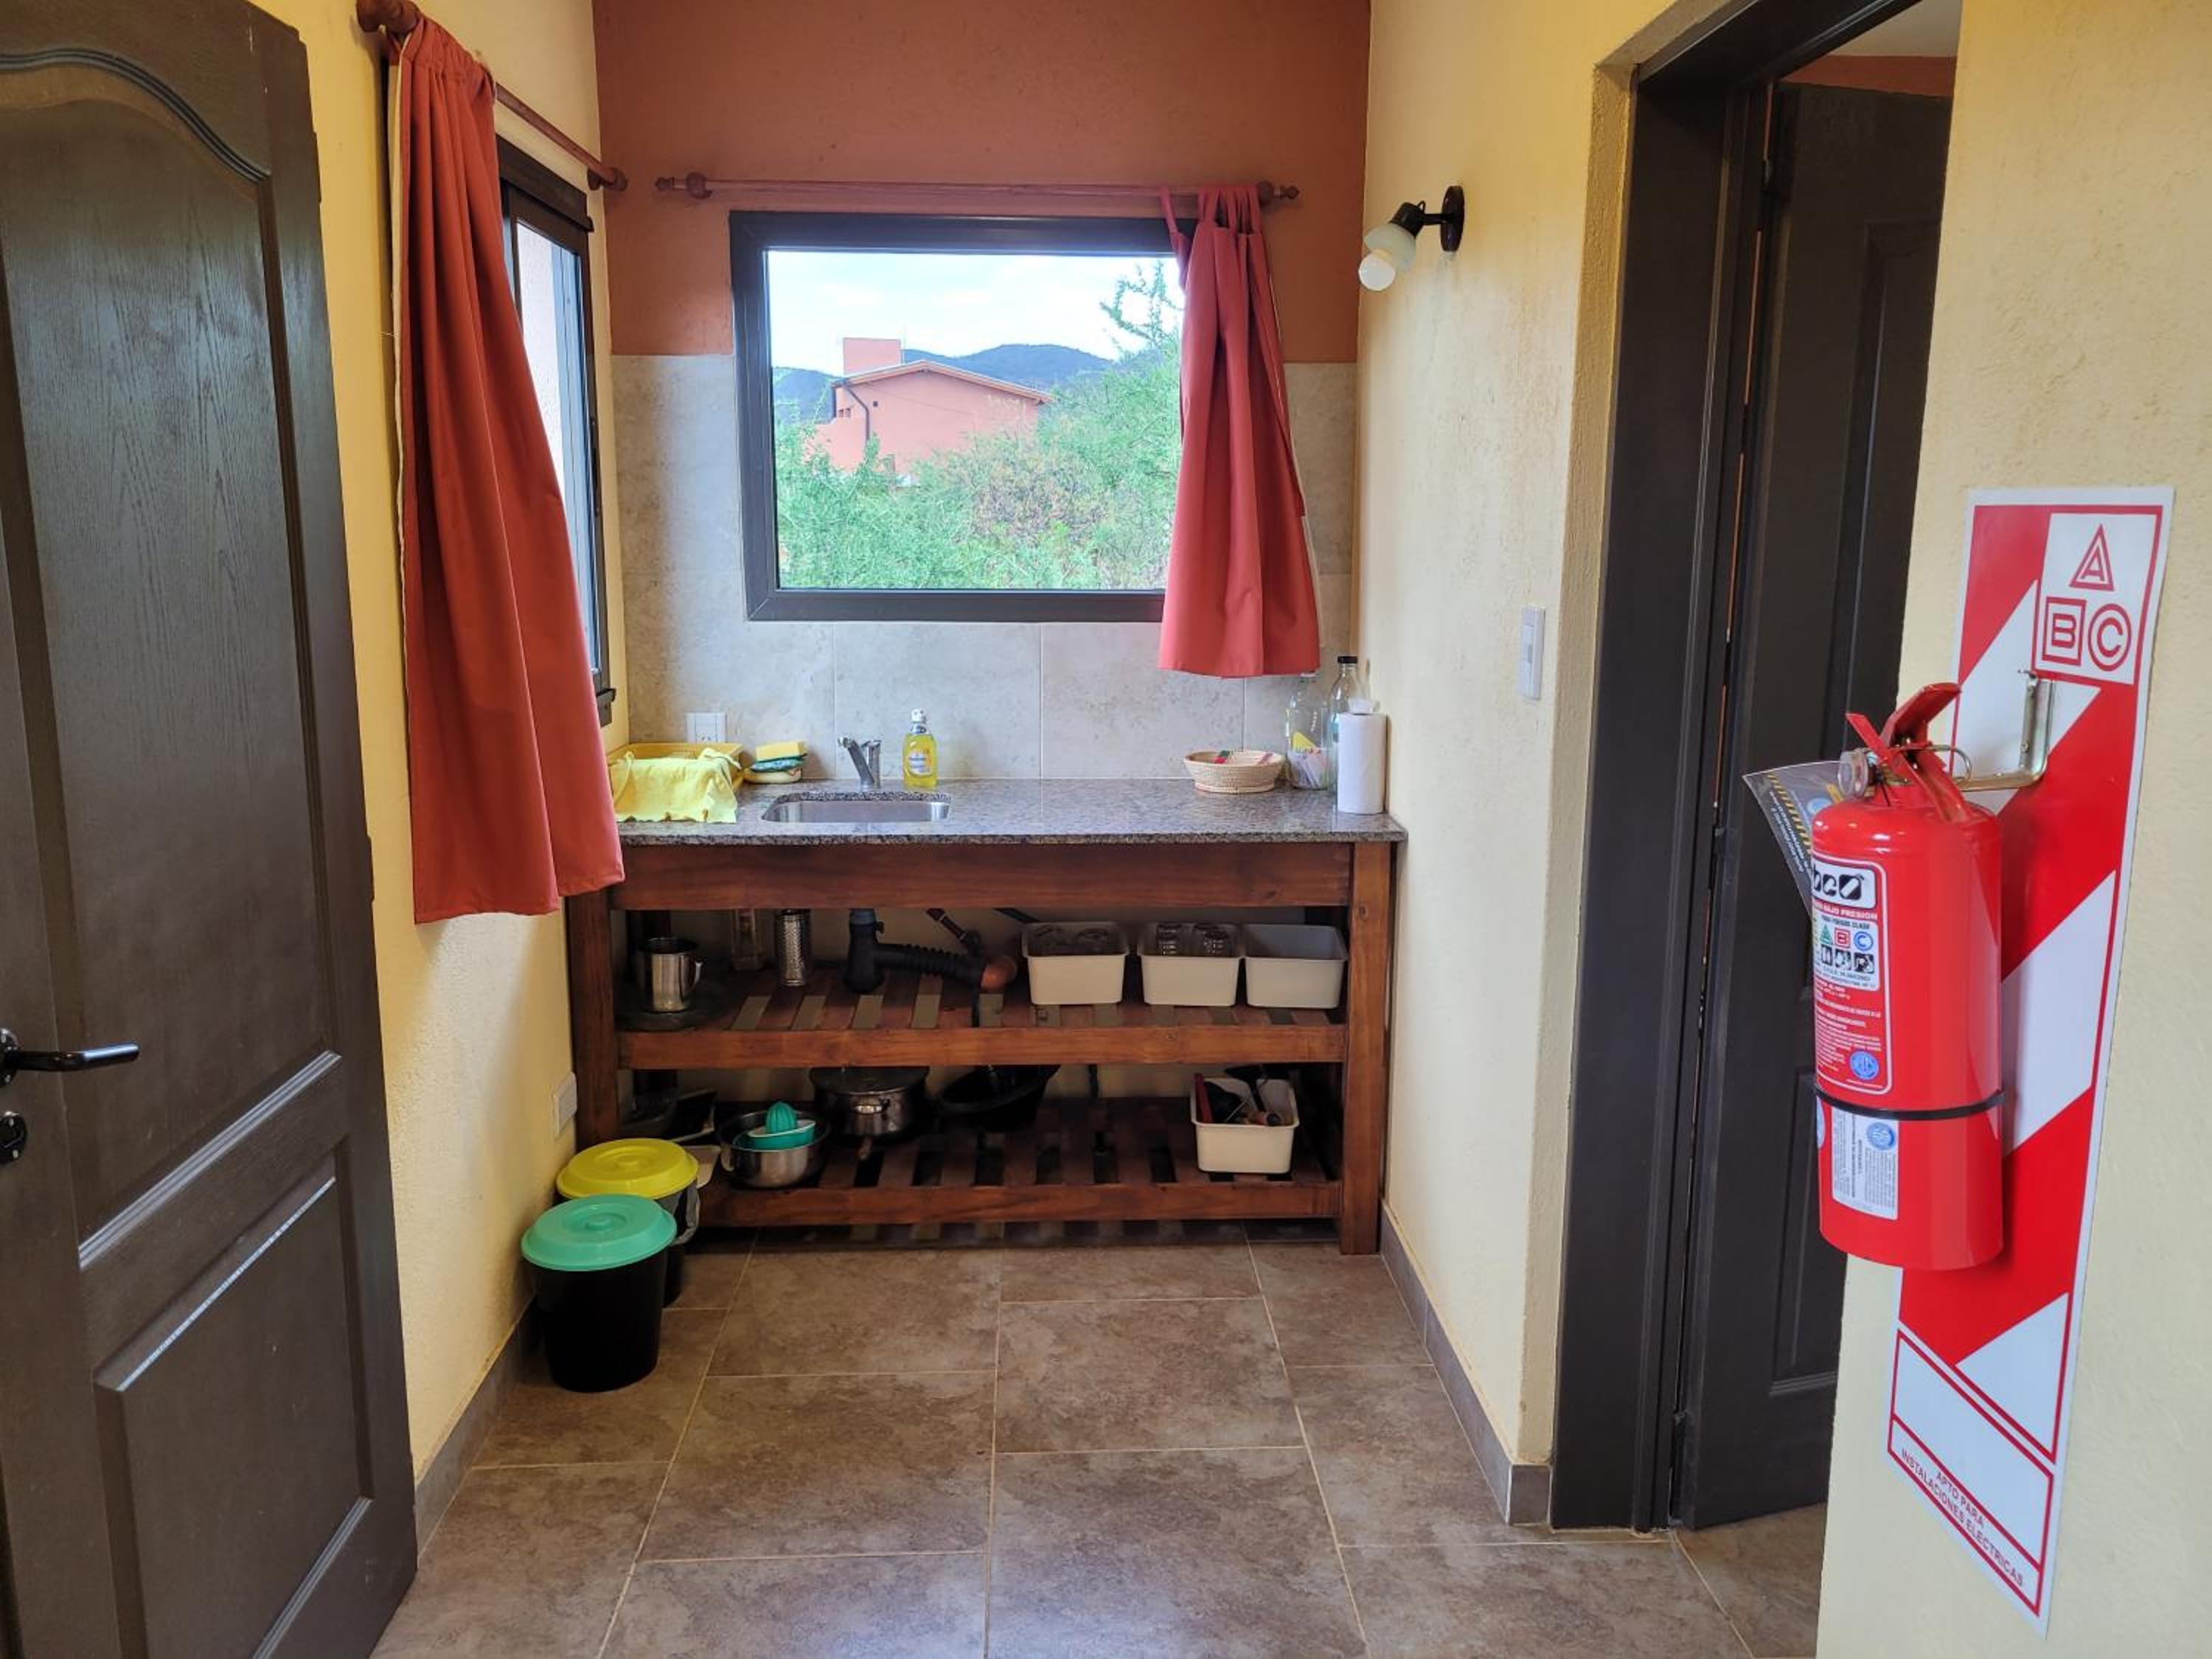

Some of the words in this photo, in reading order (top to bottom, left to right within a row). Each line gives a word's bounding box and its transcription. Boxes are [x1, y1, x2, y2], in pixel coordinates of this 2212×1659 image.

[2079, 543, 2106, 582] A
[2051, 612, 2077, 649] B
[2096, 616, 2124, 658] C
[1901, 1447, 1964, 1523] INSTALACIONES
[1935, 1472, 1959, 1500] APTO
[1961, 1495, 1985, 1528] PARA
